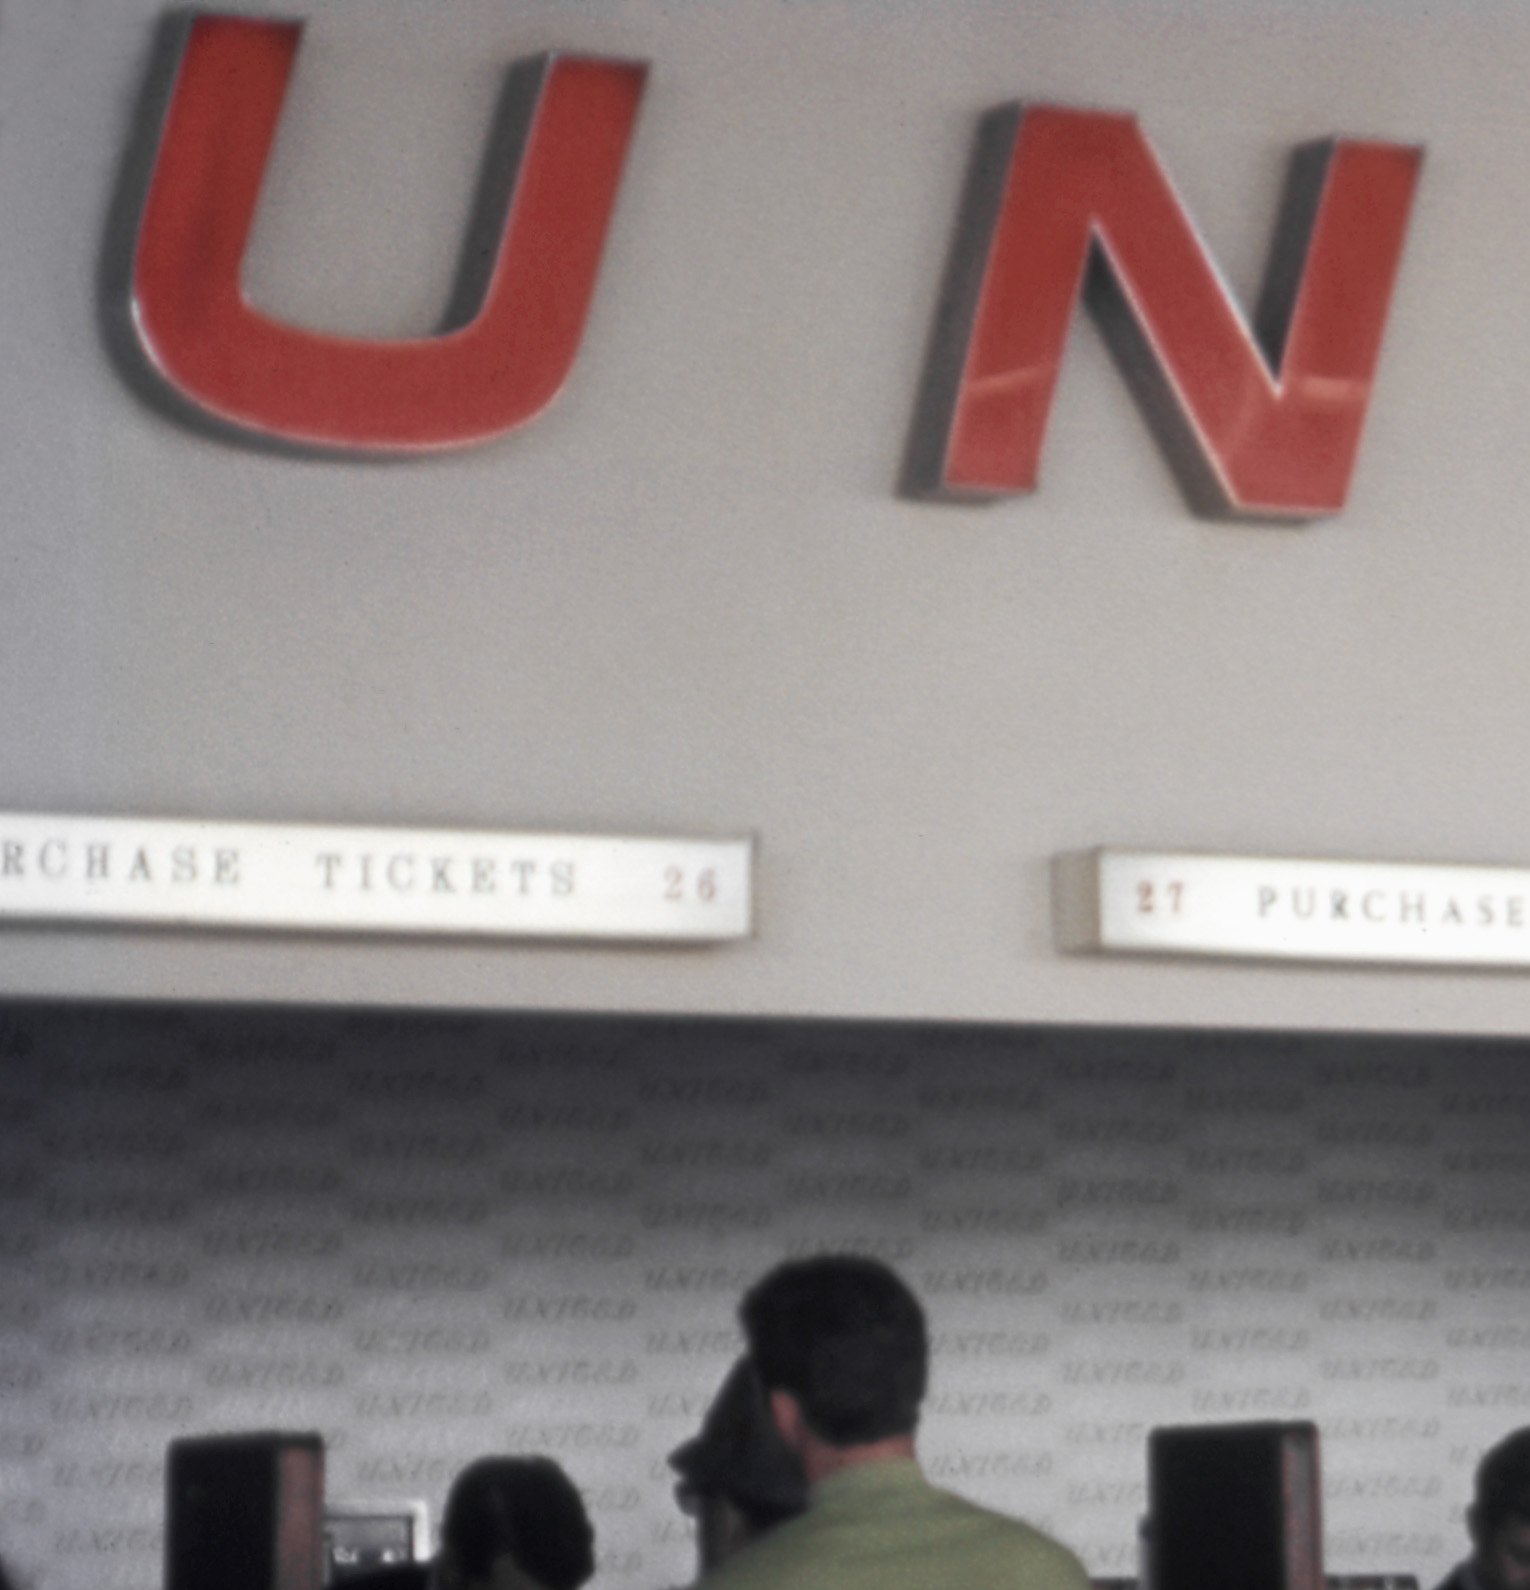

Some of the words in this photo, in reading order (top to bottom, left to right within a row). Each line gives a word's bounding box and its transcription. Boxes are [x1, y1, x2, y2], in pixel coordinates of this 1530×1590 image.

[314, 851, 577, 898] TICKETS
[663, 864, 719, 903] 26
[1135, 879, 1186, 917] 27
[1256, 884, 1526, 930] PURCHASE
